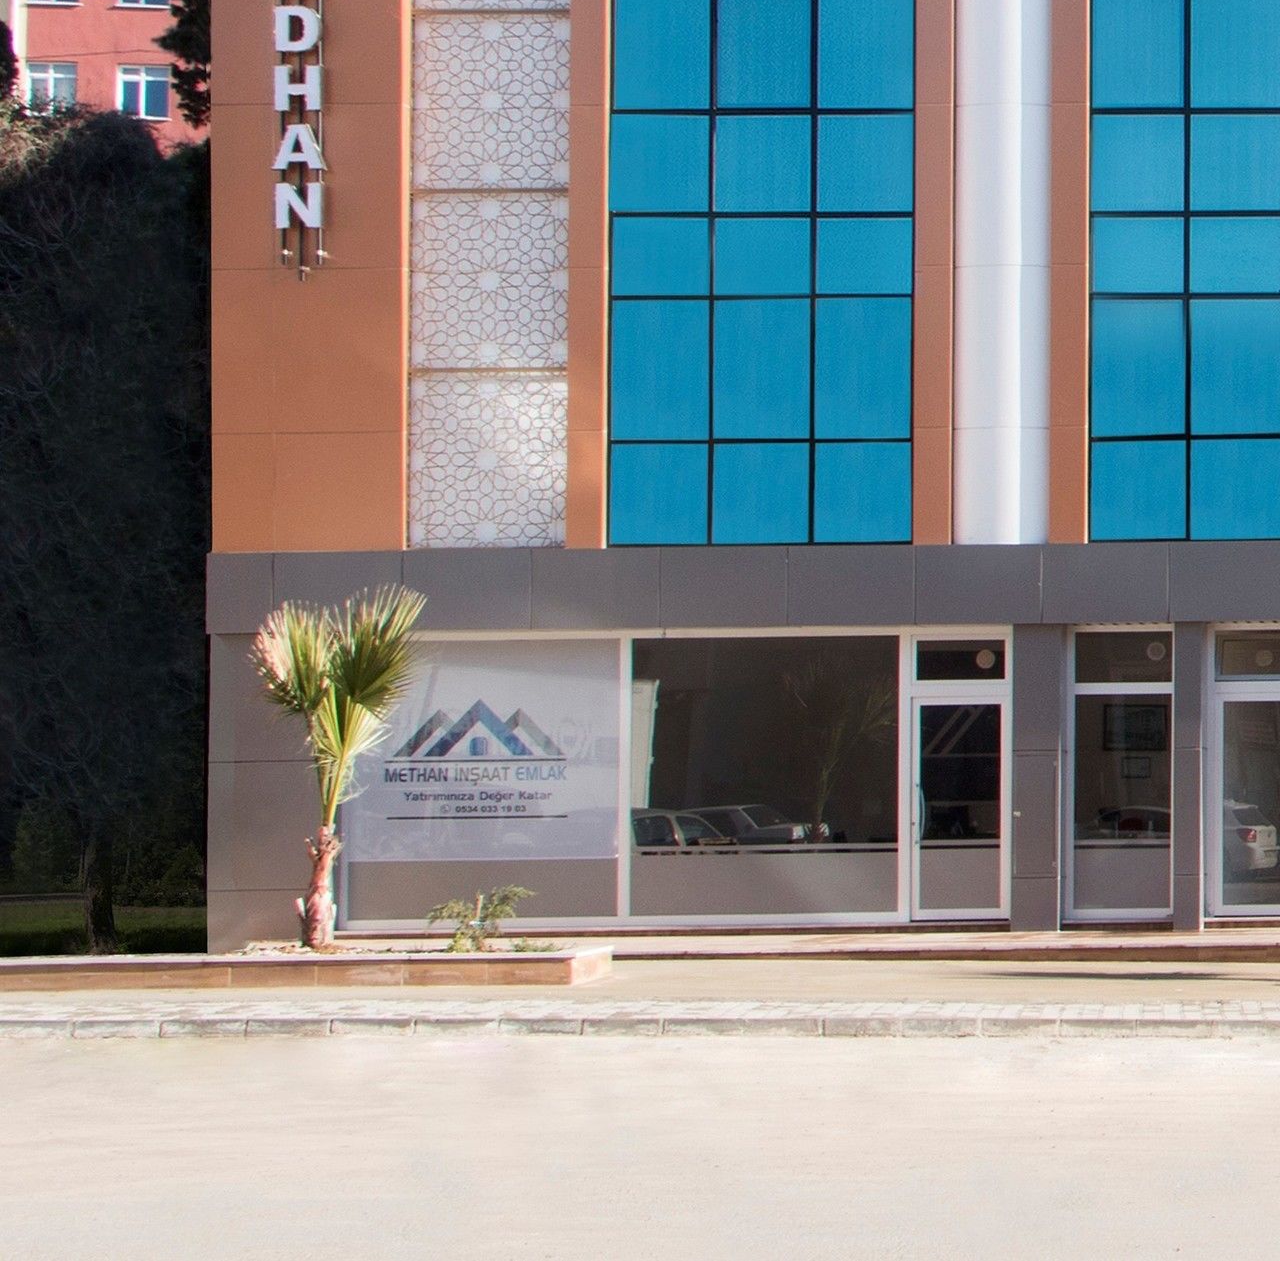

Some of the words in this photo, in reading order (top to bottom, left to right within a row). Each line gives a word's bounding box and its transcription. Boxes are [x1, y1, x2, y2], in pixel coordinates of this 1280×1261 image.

[384, 767, 449, 783] METHAN
[454, 763, 511, 786] İNŞAAT
[515, 765, 567, 782] EMLAK
[404, 791, 475, 802] Yatırımınıza
[479, 791, 514, 802] Değer
[519, 791, 552, 801] Katar
